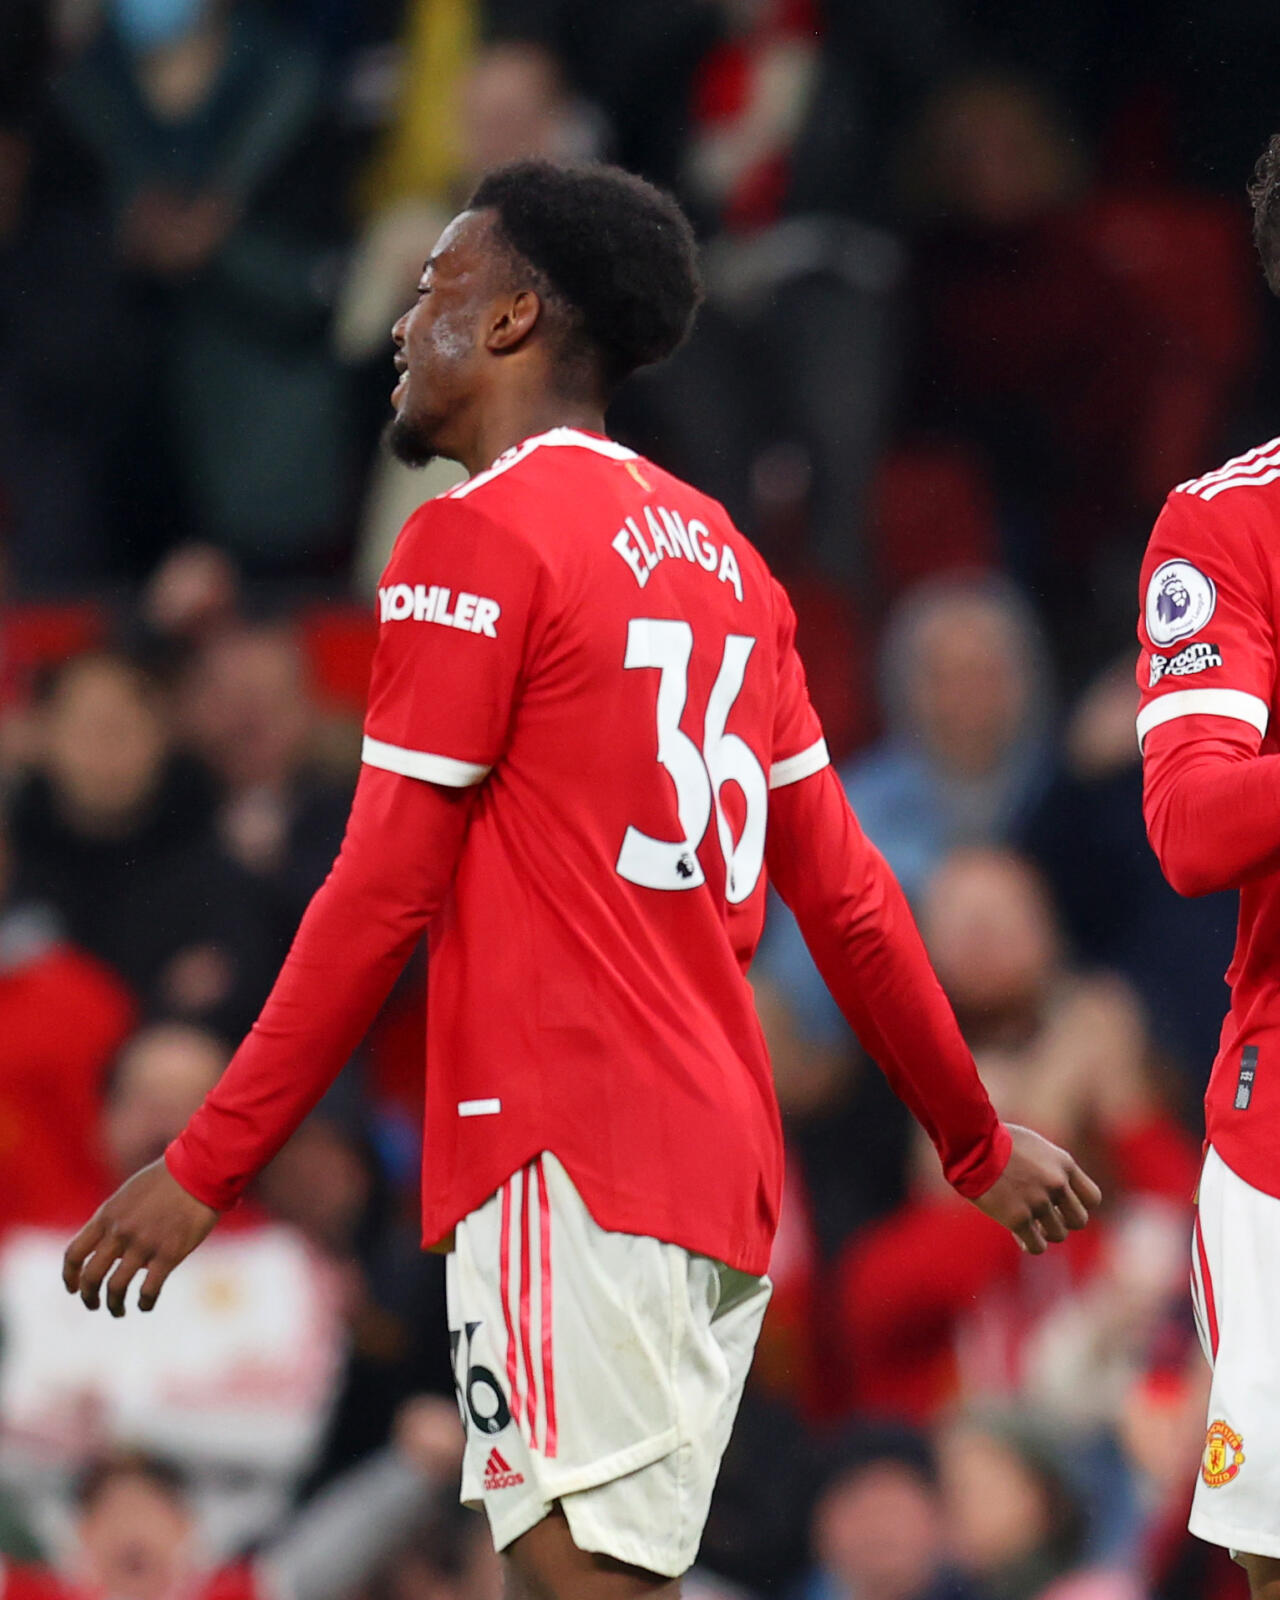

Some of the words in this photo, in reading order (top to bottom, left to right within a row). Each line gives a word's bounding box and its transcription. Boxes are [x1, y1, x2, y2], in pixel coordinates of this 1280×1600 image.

[611, 505, 744, 602] ELANGA
[1169, 642, 1212, 668] room
[616, 617, 768, 905] 36
